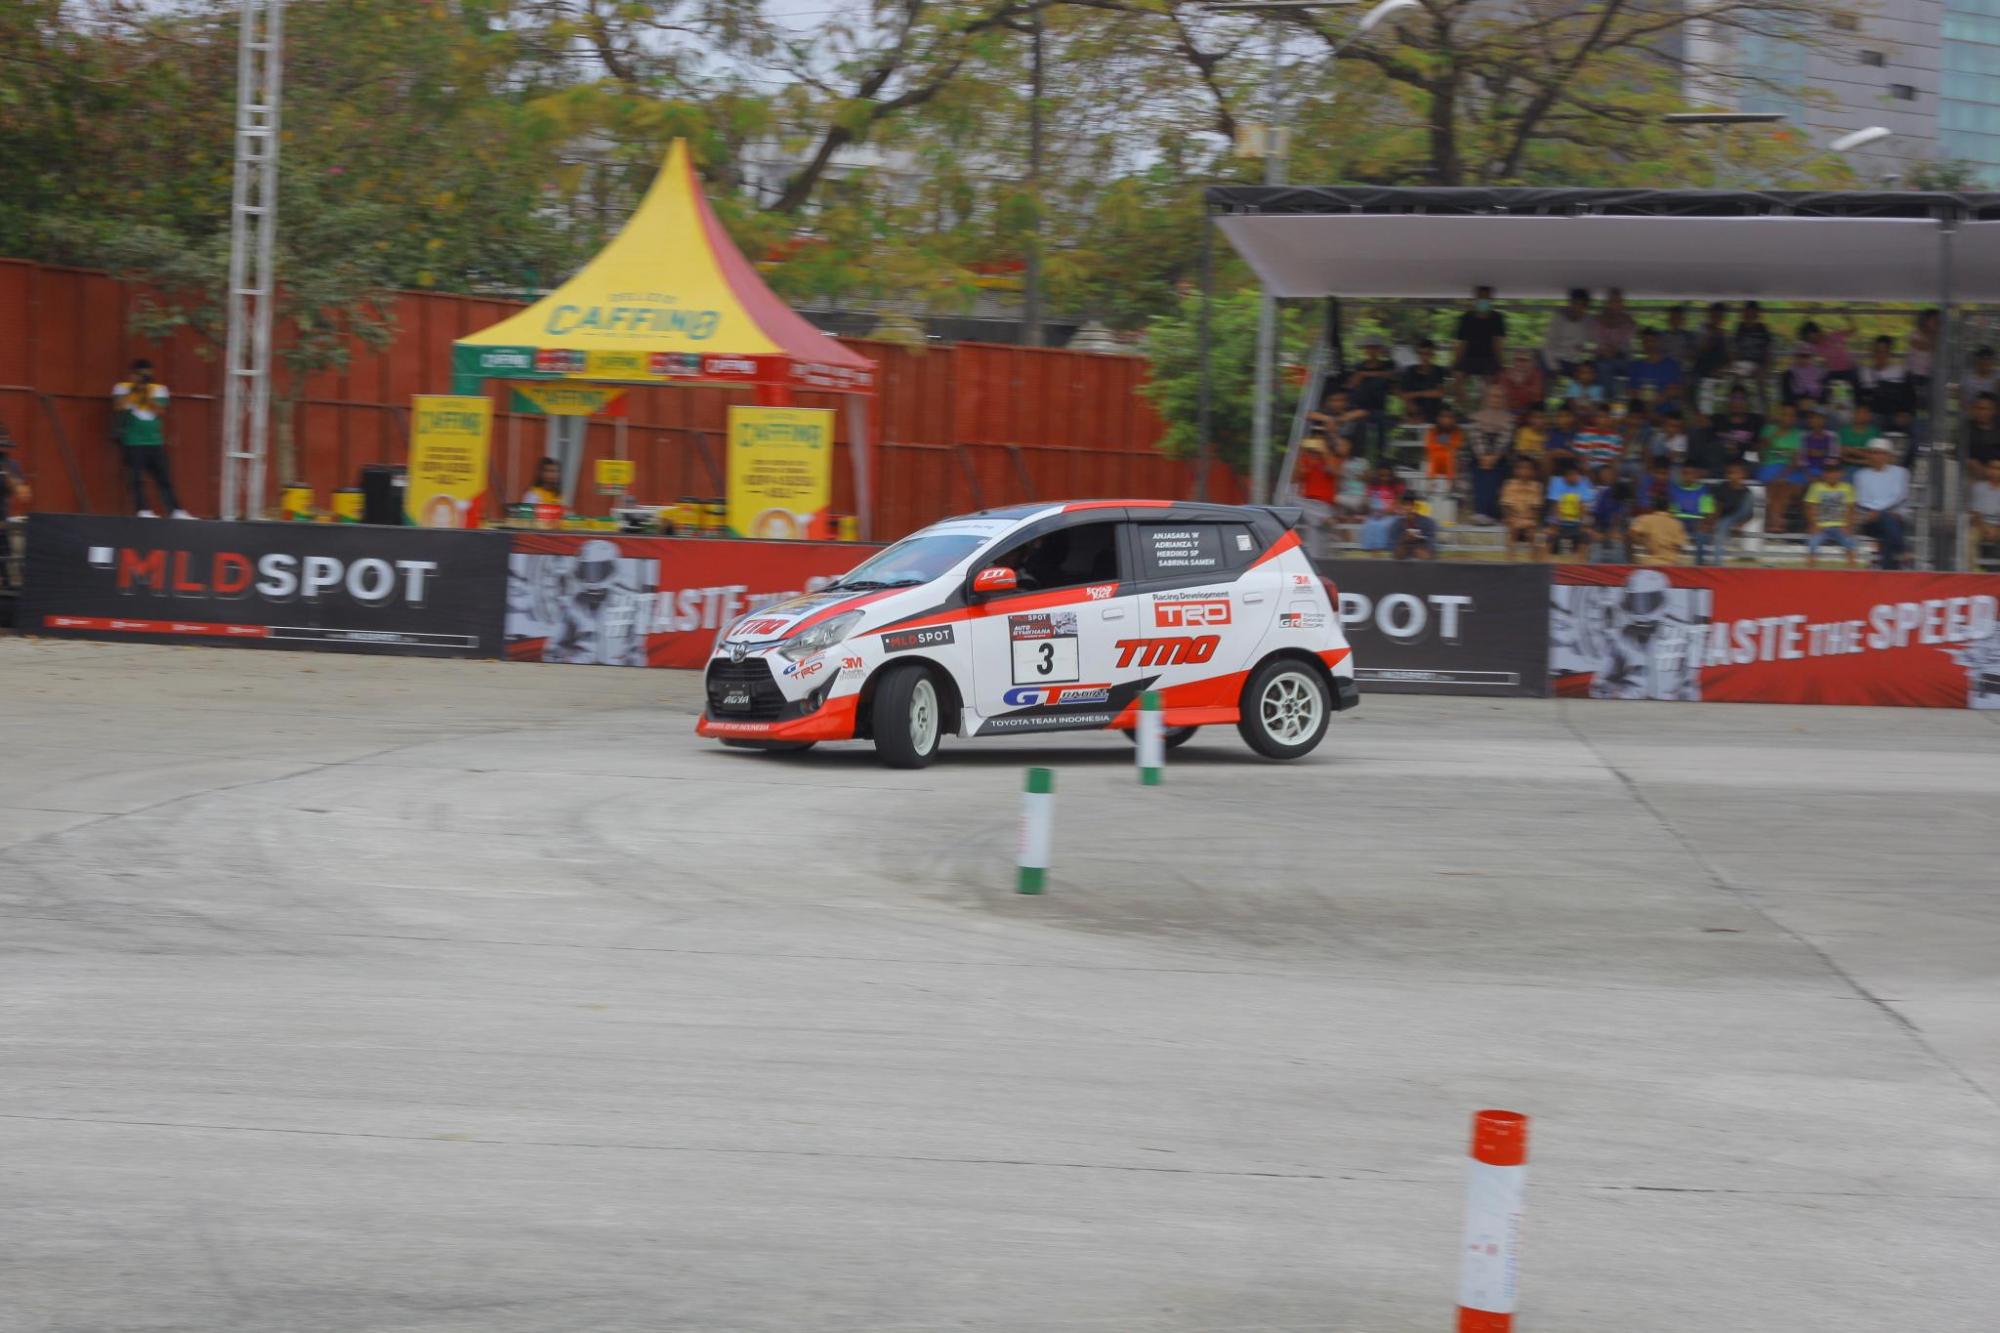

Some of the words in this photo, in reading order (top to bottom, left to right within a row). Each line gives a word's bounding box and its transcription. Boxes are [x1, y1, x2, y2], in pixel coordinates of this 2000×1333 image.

[1806, 620, 1867, 656] THE
[1867, 595, 1998, 649] SPEED
[842, 656, 863, 669] 3M
[1037, 642, 1054, 675] 3
[991, 719, 1030, 727] TOYOTA
[1031, 717, 1057, 725] TEAM
[1059, 715, 1110, 723] INDONESIA
